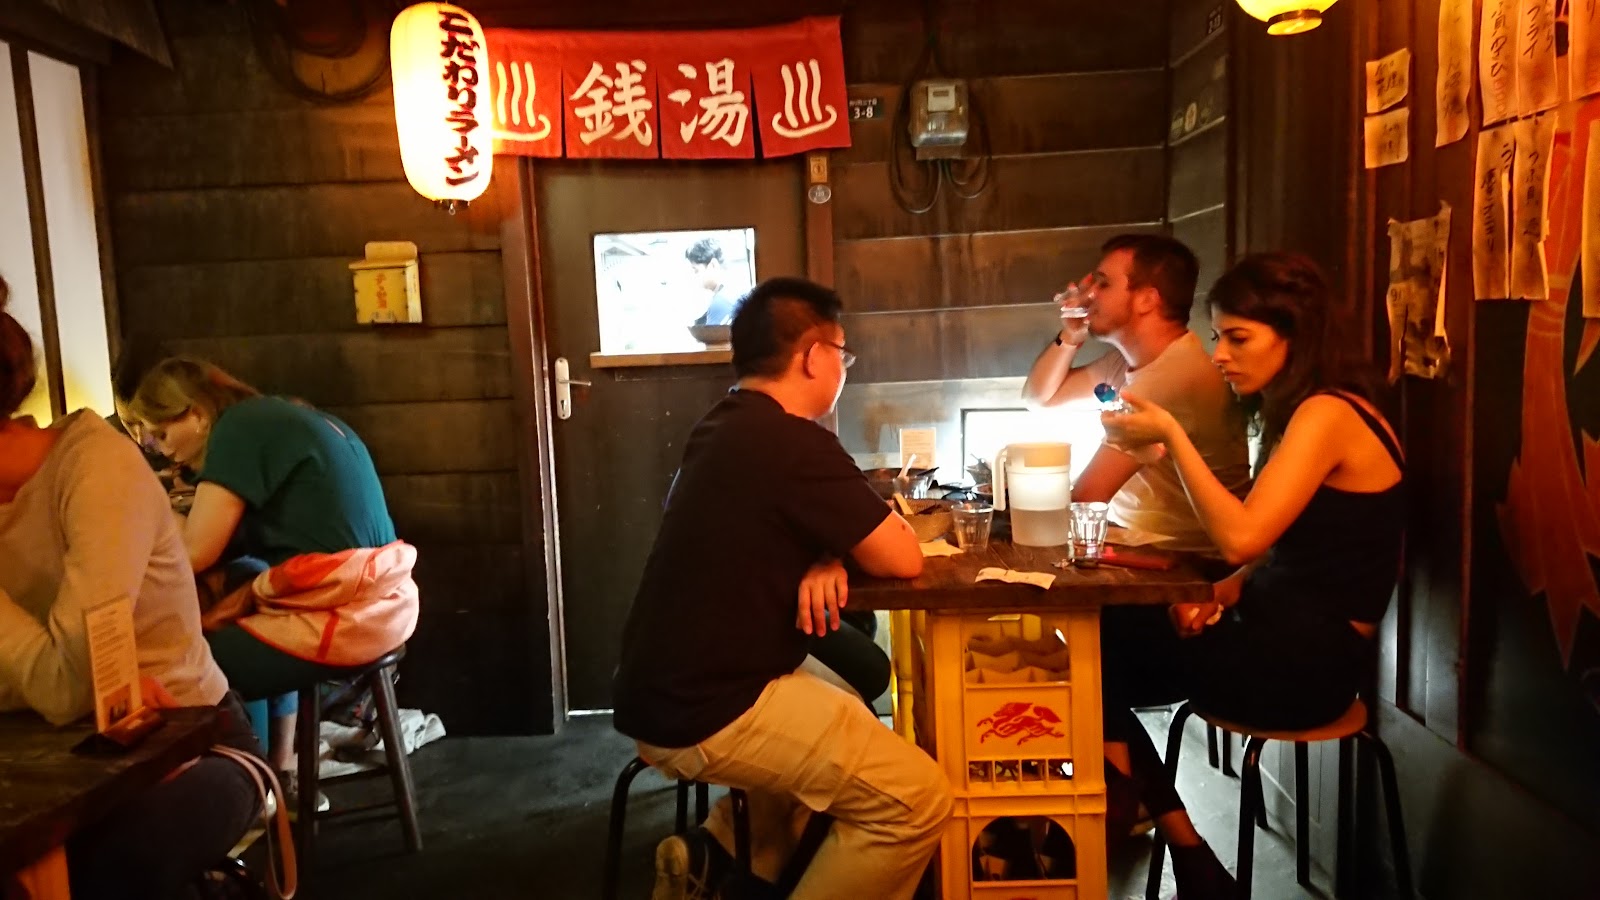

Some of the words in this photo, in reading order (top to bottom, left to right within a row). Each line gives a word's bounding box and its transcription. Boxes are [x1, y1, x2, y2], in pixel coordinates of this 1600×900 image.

[437, 11, 481, 186] こだわりラーメン
[568, 58, 750, 148] 銭湯
[854, 106, 874, 119] 3-8
